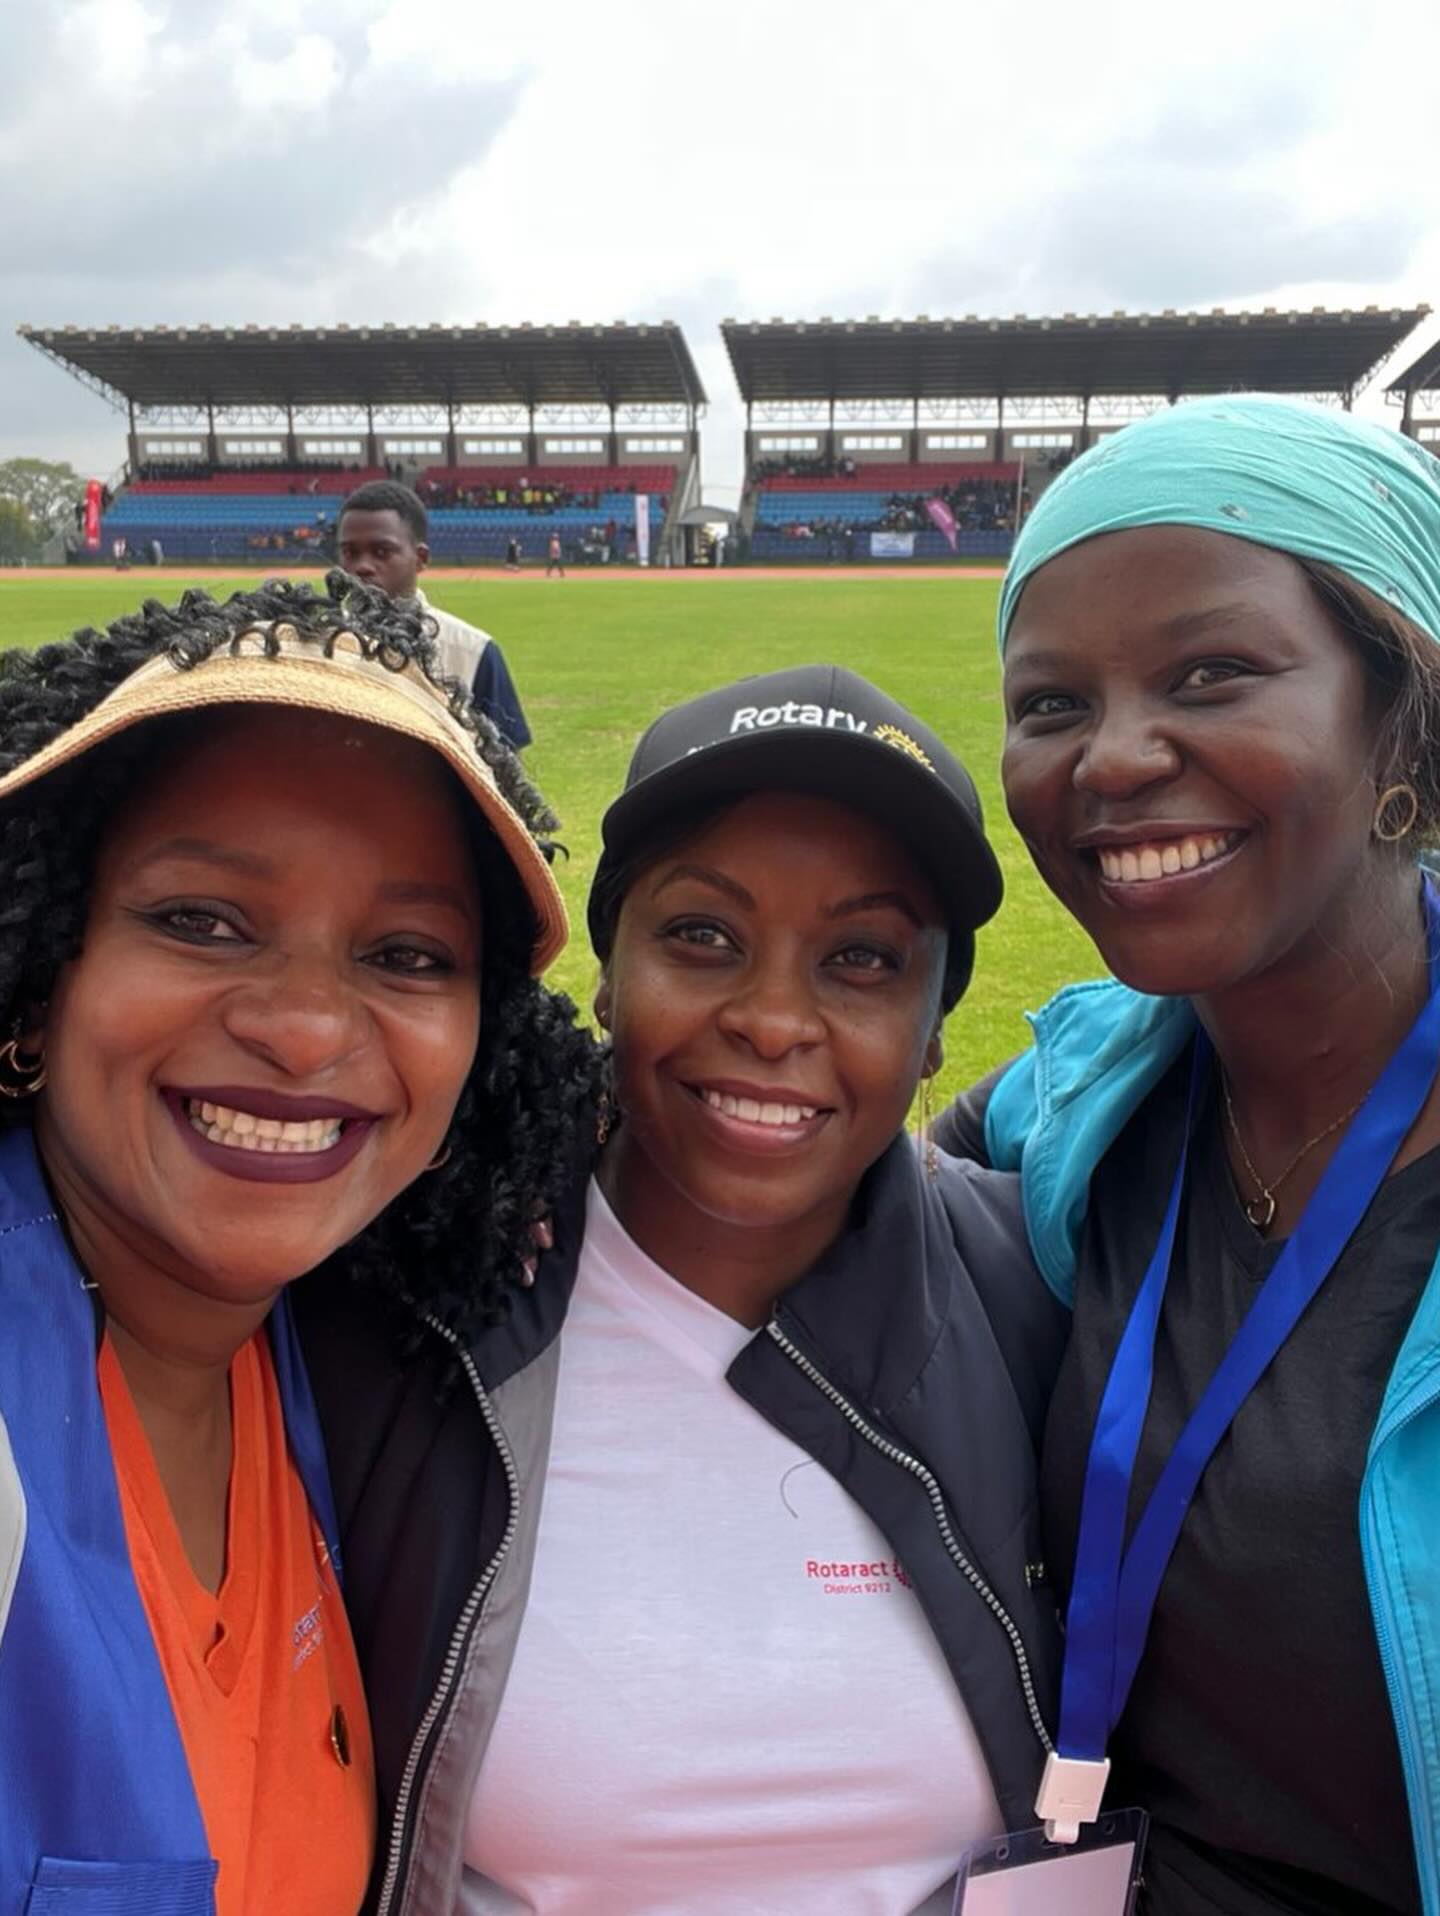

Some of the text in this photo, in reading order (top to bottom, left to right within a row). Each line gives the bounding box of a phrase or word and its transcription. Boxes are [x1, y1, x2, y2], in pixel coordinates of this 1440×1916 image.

[806, 1561, 888, 1577] Rotaract
[824, 1582, 891, 1594] District 9212
